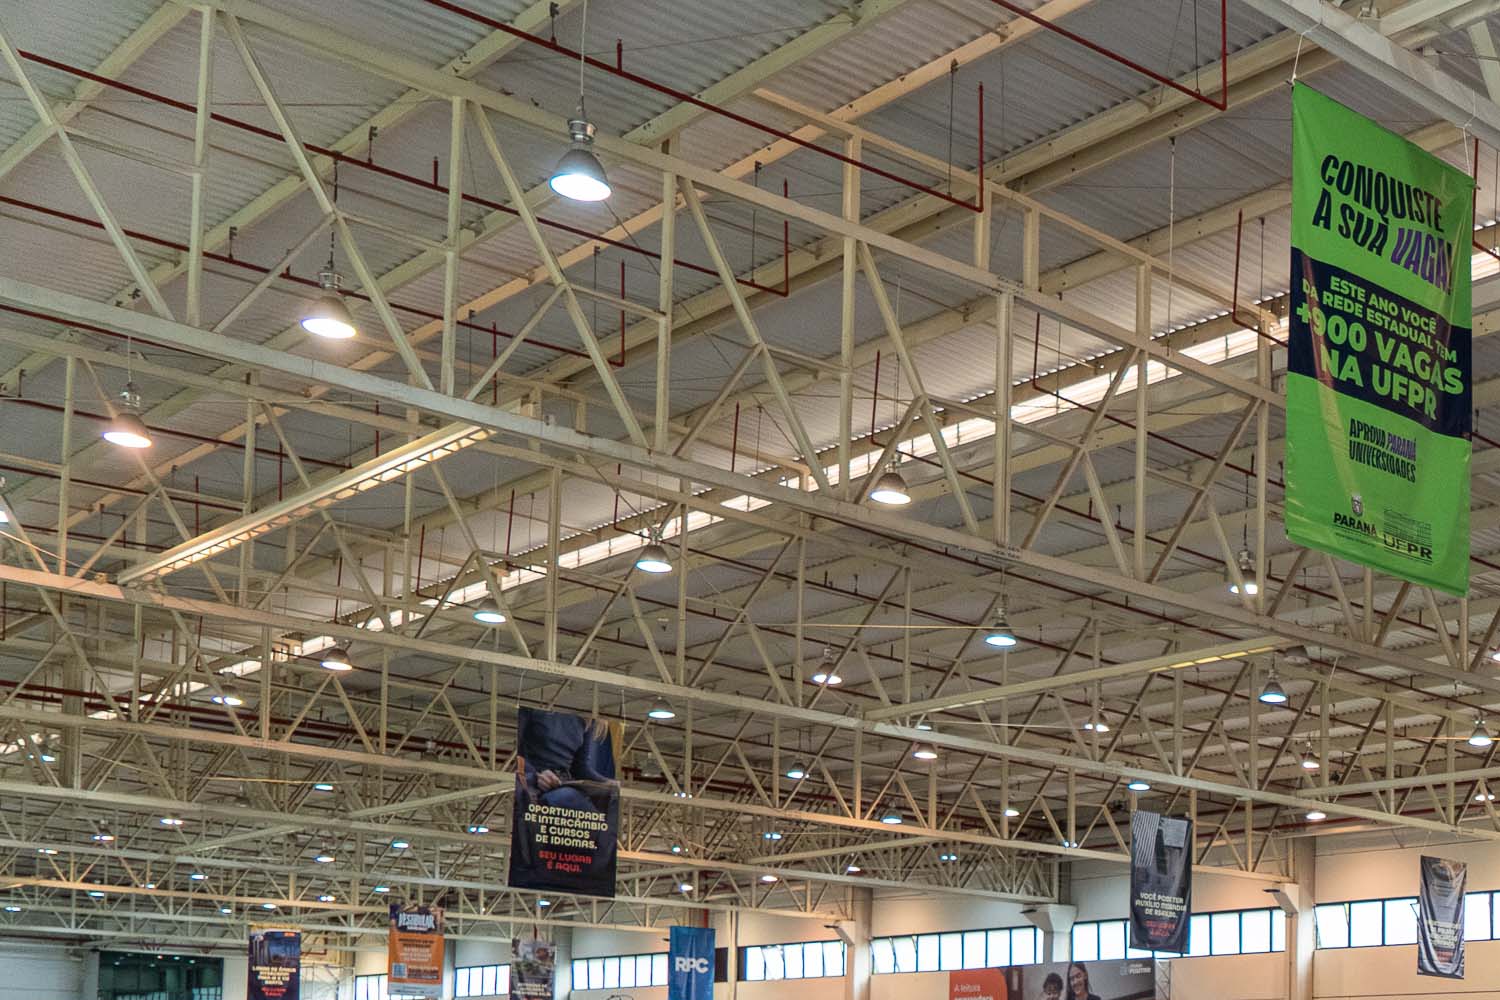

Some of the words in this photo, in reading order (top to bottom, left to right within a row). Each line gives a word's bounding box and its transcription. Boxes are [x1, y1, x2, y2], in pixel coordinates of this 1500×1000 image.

[1320, 154, 1445, 233] CONQUISTE
[1312, 187, 1333, 231] A
[1338, 202, 1389, 257] SUA
[1302, 278, 1319, 301] DA
[1322, 290, 1363, 318] REDE
[1366, 309, 1433, 350] ESTADUAL
[1435, 339, 1457, 363] TEM
[1330, 276, 1366, 302] ESTE
[1368, 294, 1399, 316] ANO
[1401, 307, 1437, 335] VOCÊ
[1296, 301, 1367, 352] +900
[1374, 330, 1464, 395] VAGAS
[1320, 343, 1364, 388] NA
[1372, 364, 1437, 421] UFPR
[1349, 418, 1386, 448] APROVA
[1349, 440, 1416, 483] UNIVERSIDADES
[1383, 533, 1432, 560] UFPR
[524, 812, 537, 823] DE
[538, 815, 608, 832] INTERCÂMBIO
[528, 804, 606, 821] OPORTUNIDADE
[535, 834, 548, 844] DE
[551, 837, 598, 849] IDIOMAS.
[540, 825, 547, 834] E
[549, 826, 590, 839] CURSOS
[538, 850, 557, 860] SEU
[560, 853, 593, 864] LUGAR
[675, 956, 709, 974] RPC
